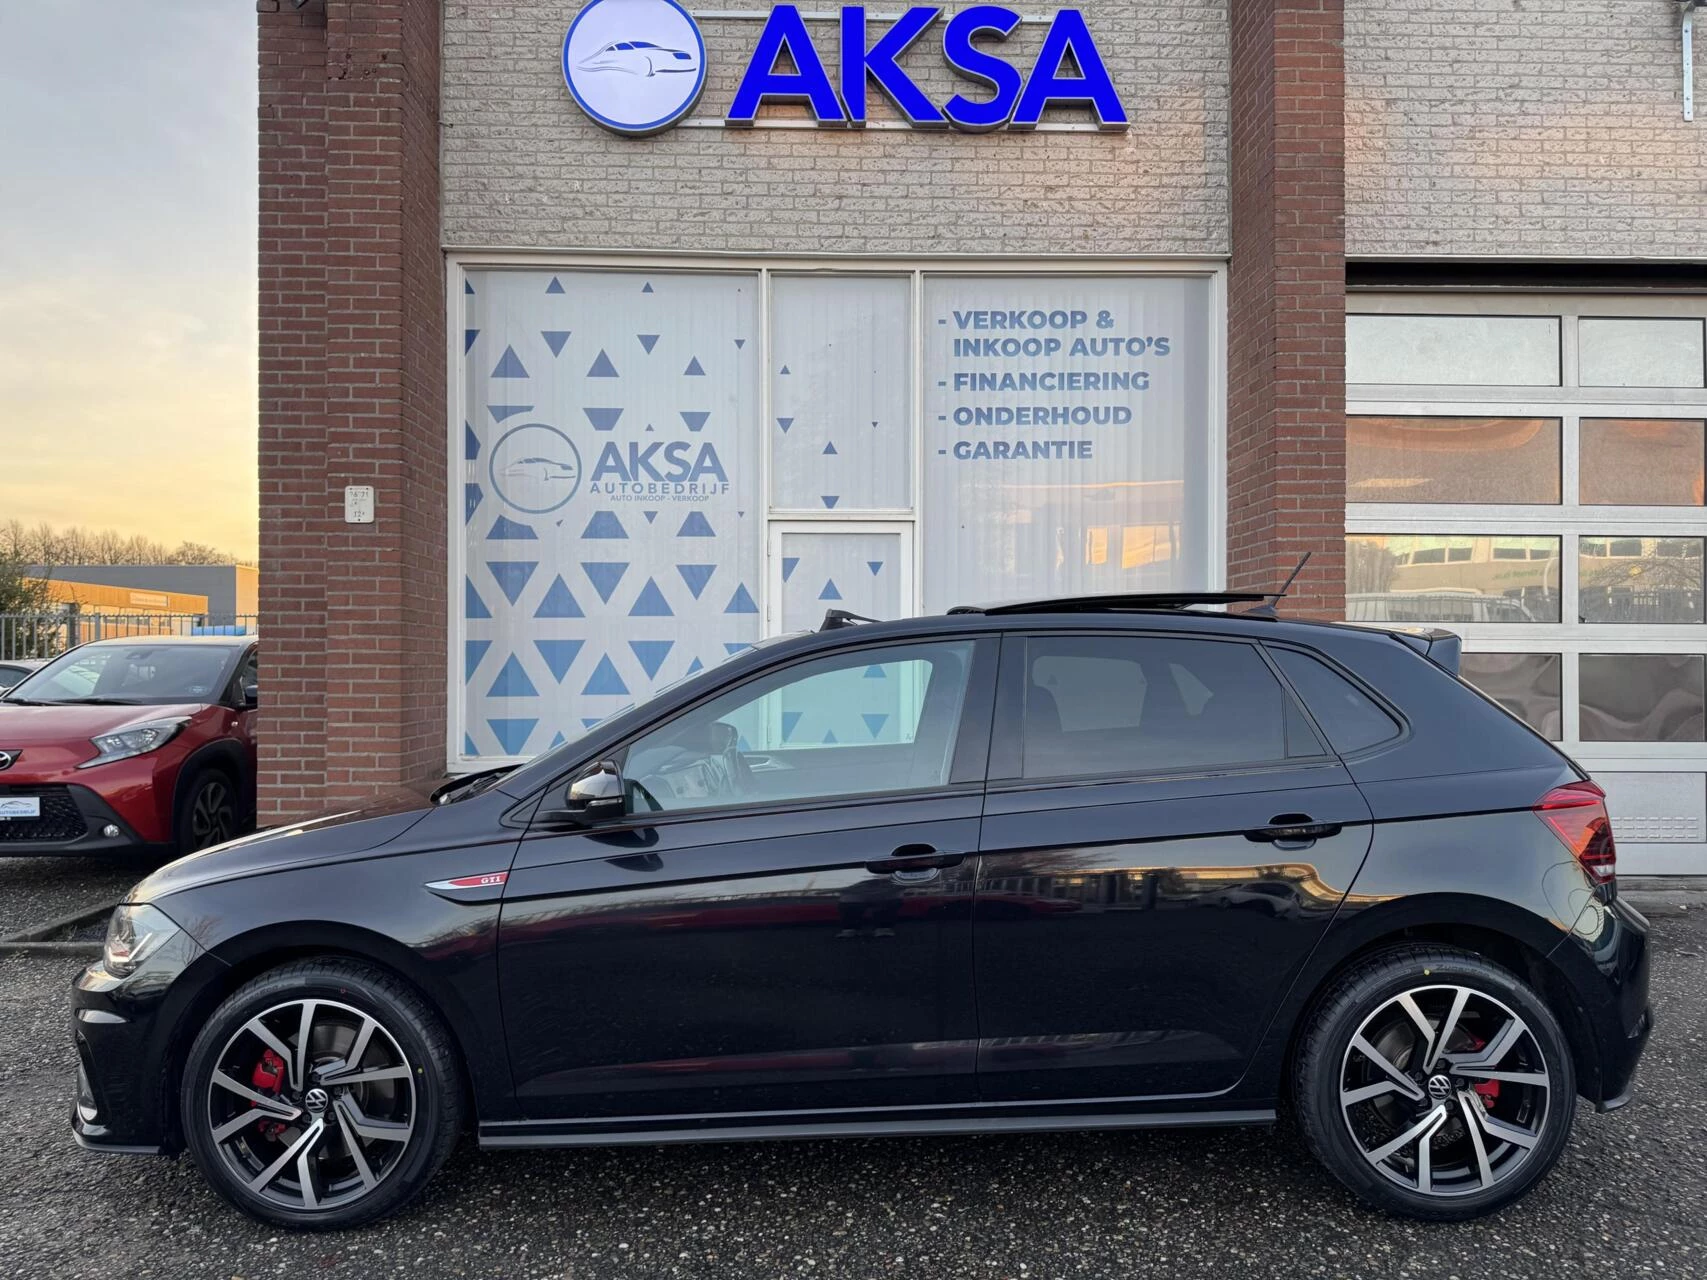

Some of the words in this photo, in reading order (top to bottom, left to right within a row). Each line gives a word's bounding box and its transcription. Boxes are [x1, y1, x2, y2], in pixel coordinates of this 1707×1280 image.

[725, 3, 1131, 134] AKSA
[953, 310, 1087, 330] VERKOOP
[1096, 310, 1114, 329] &
[953, 337, 1062, 358] INKOOP
[1069, 335, 1171, 357] AUTO'S
[953, 371, 1150, 392] FINANCIERING
[953, 405, 1133, 426] ONDERHOUD
[953, 439, 1093, 460] GARANTIE
[590, 441, 729, 482] AKSA
[590, 483, 730, 494] AUTOBEDRIJF
[481, 876, 500, 884] GTI
